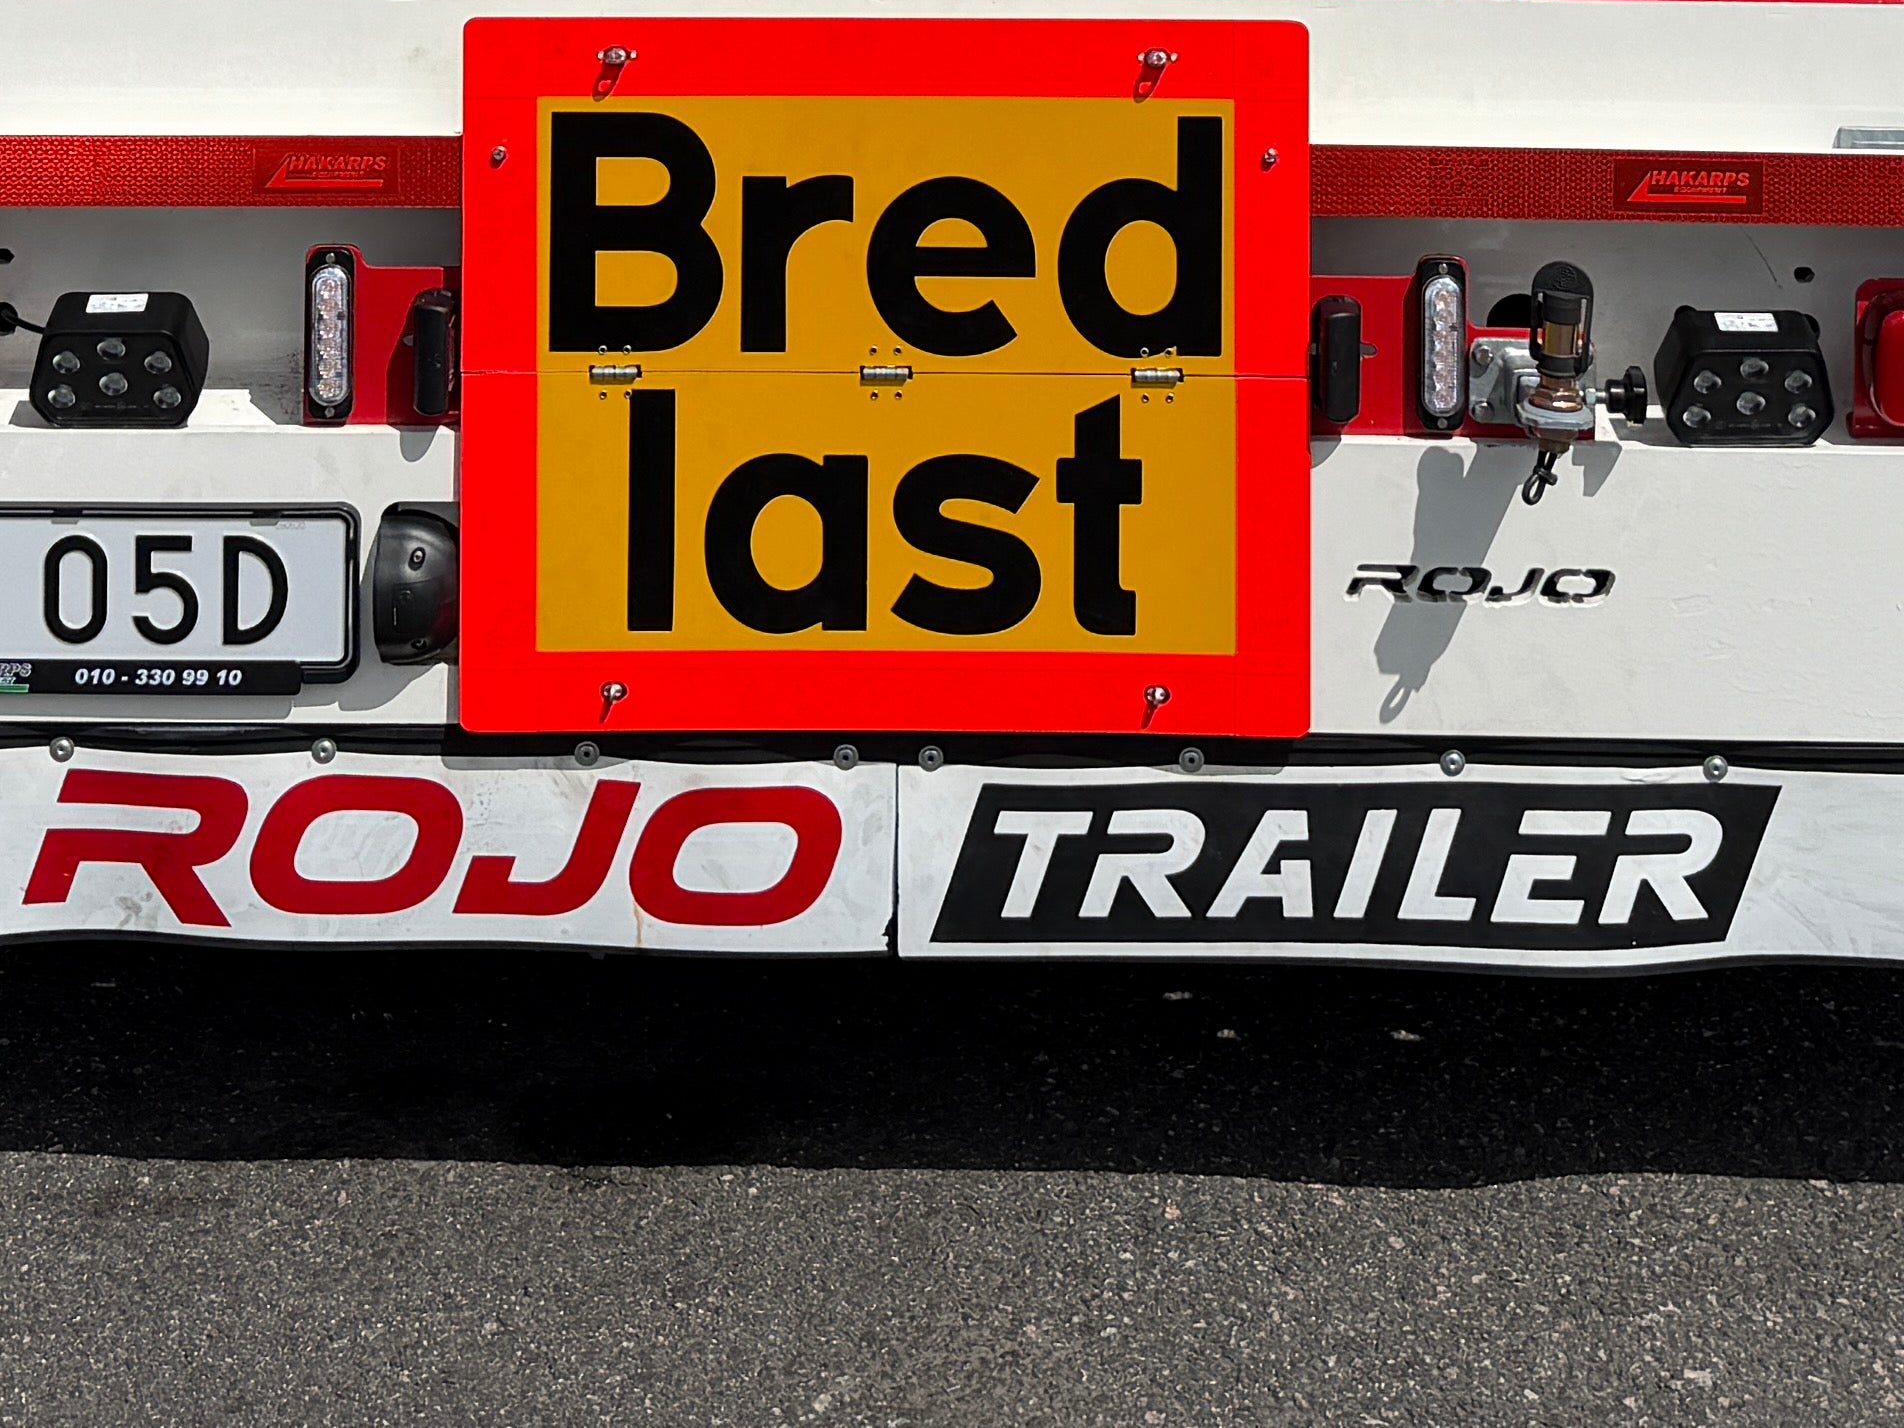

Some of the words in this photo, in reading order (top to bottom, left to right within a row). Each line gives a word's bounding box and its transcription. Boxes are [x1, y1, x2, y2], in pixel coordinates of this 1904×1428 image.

[289, 156, 387, 171] HAKARPS
[1651, 170, 1750, 187] HAKARPS
[548, 111, 1223, 358] Bred
[628, 389, 1142, 636] last
[44, 535, 289, 645] 05D
[1346, 564, 1616, 604] ROJO
[75, 668, 115, 685] 010
[135, 669, 175, 685] 330
[182, 669, 209, 685] 99
[216, 669, 242, 686] 10
[21, 768, 844, 928] ROJO
[992, 808, 1724, 924] TRAILER
